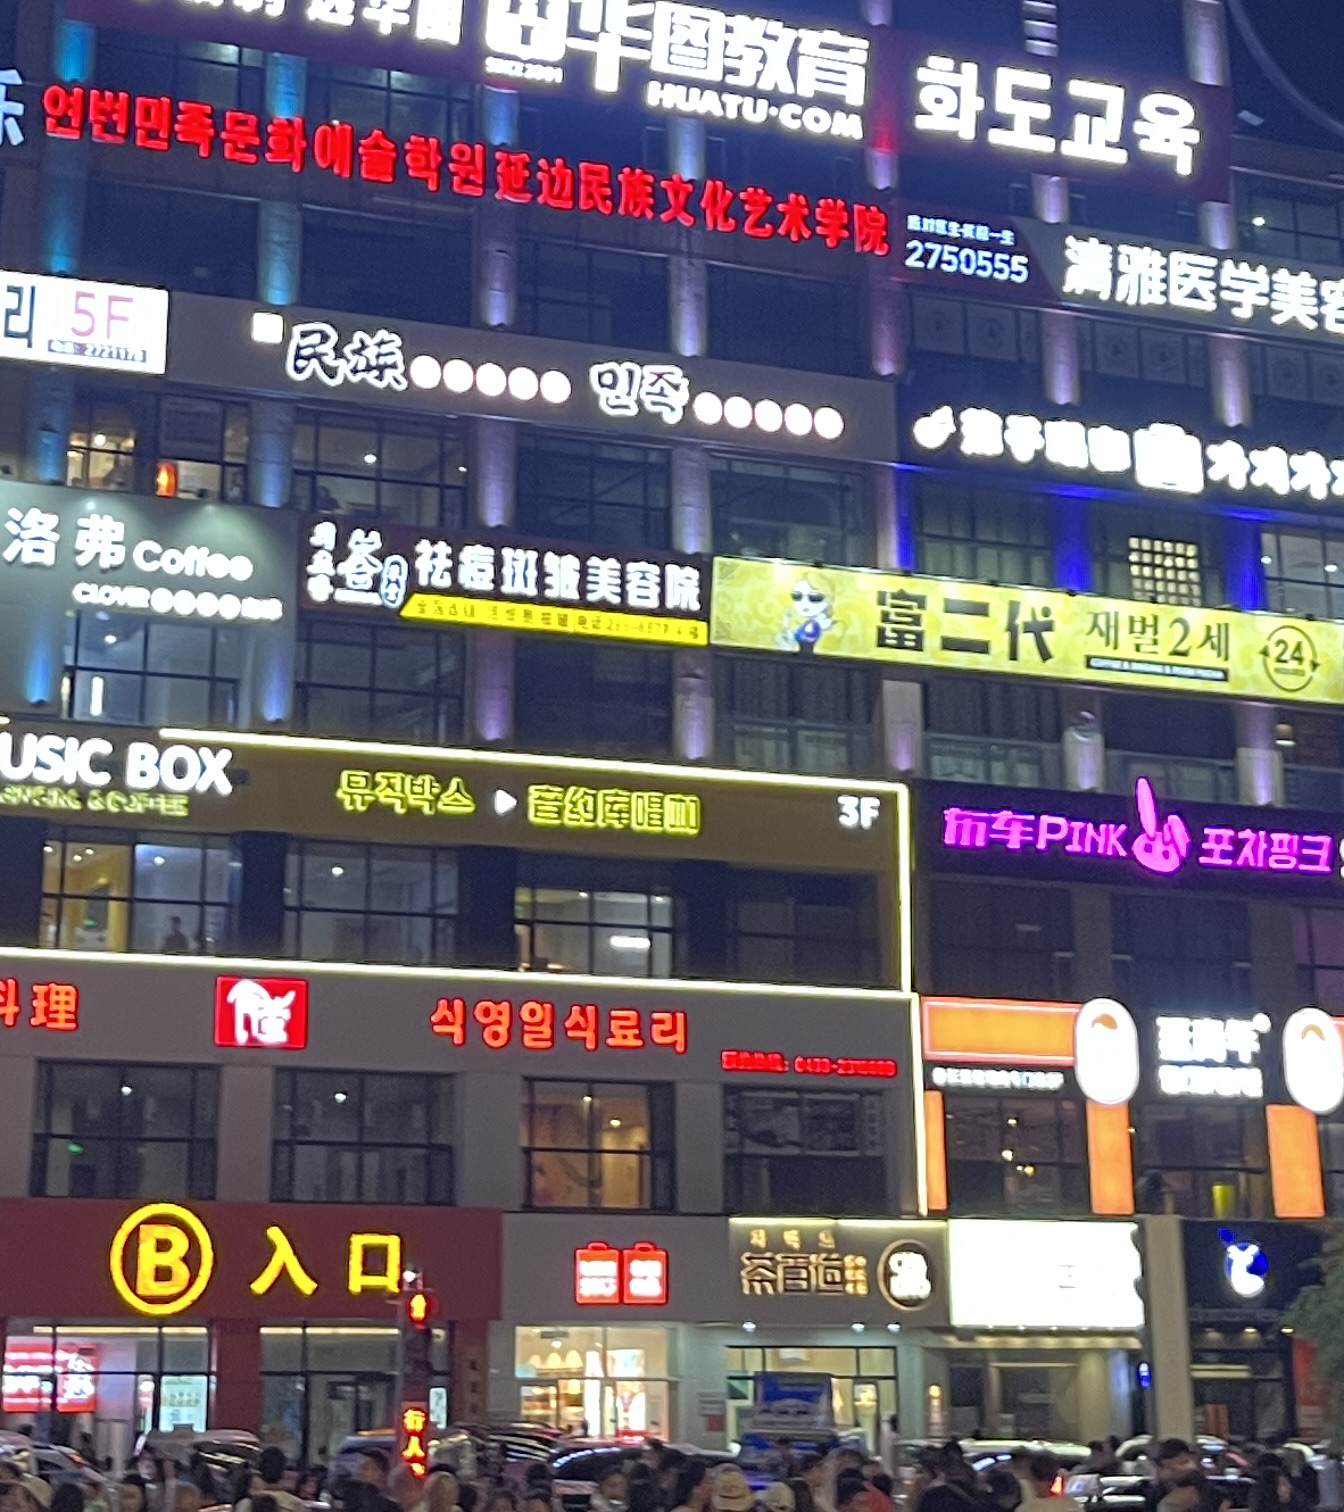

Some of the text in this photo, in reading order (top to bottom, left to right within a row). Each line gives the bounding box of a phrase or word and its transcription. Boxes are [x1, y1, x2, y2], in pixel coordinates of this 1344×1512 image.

[914, 54, 1201, 178] 화도교육
[494, 147, 892, 257] 延边民族文化艺术学院
[904, 239, 1030, 284] 2750555
[70, 290, 135, 340] 5F
[285, 320, 408, 392] 民族
[589, 360, 690, 425] 민족
[875, 588, 1056, 664] 富二代
[1086, 609, 1231, 663] 재벌2세
[1273, 637, 1305, 667] 24
[124, 740, 235, 797] BOX
[336, 768, 476, 817] 뮤직박스
[836, 794, 881, 830] 3F
[1197, 826, 1334, 875] 포차핑크
[430, 997, 689, 1055] 식영일식료리
[249, 1225, 402, 1297] 入口
